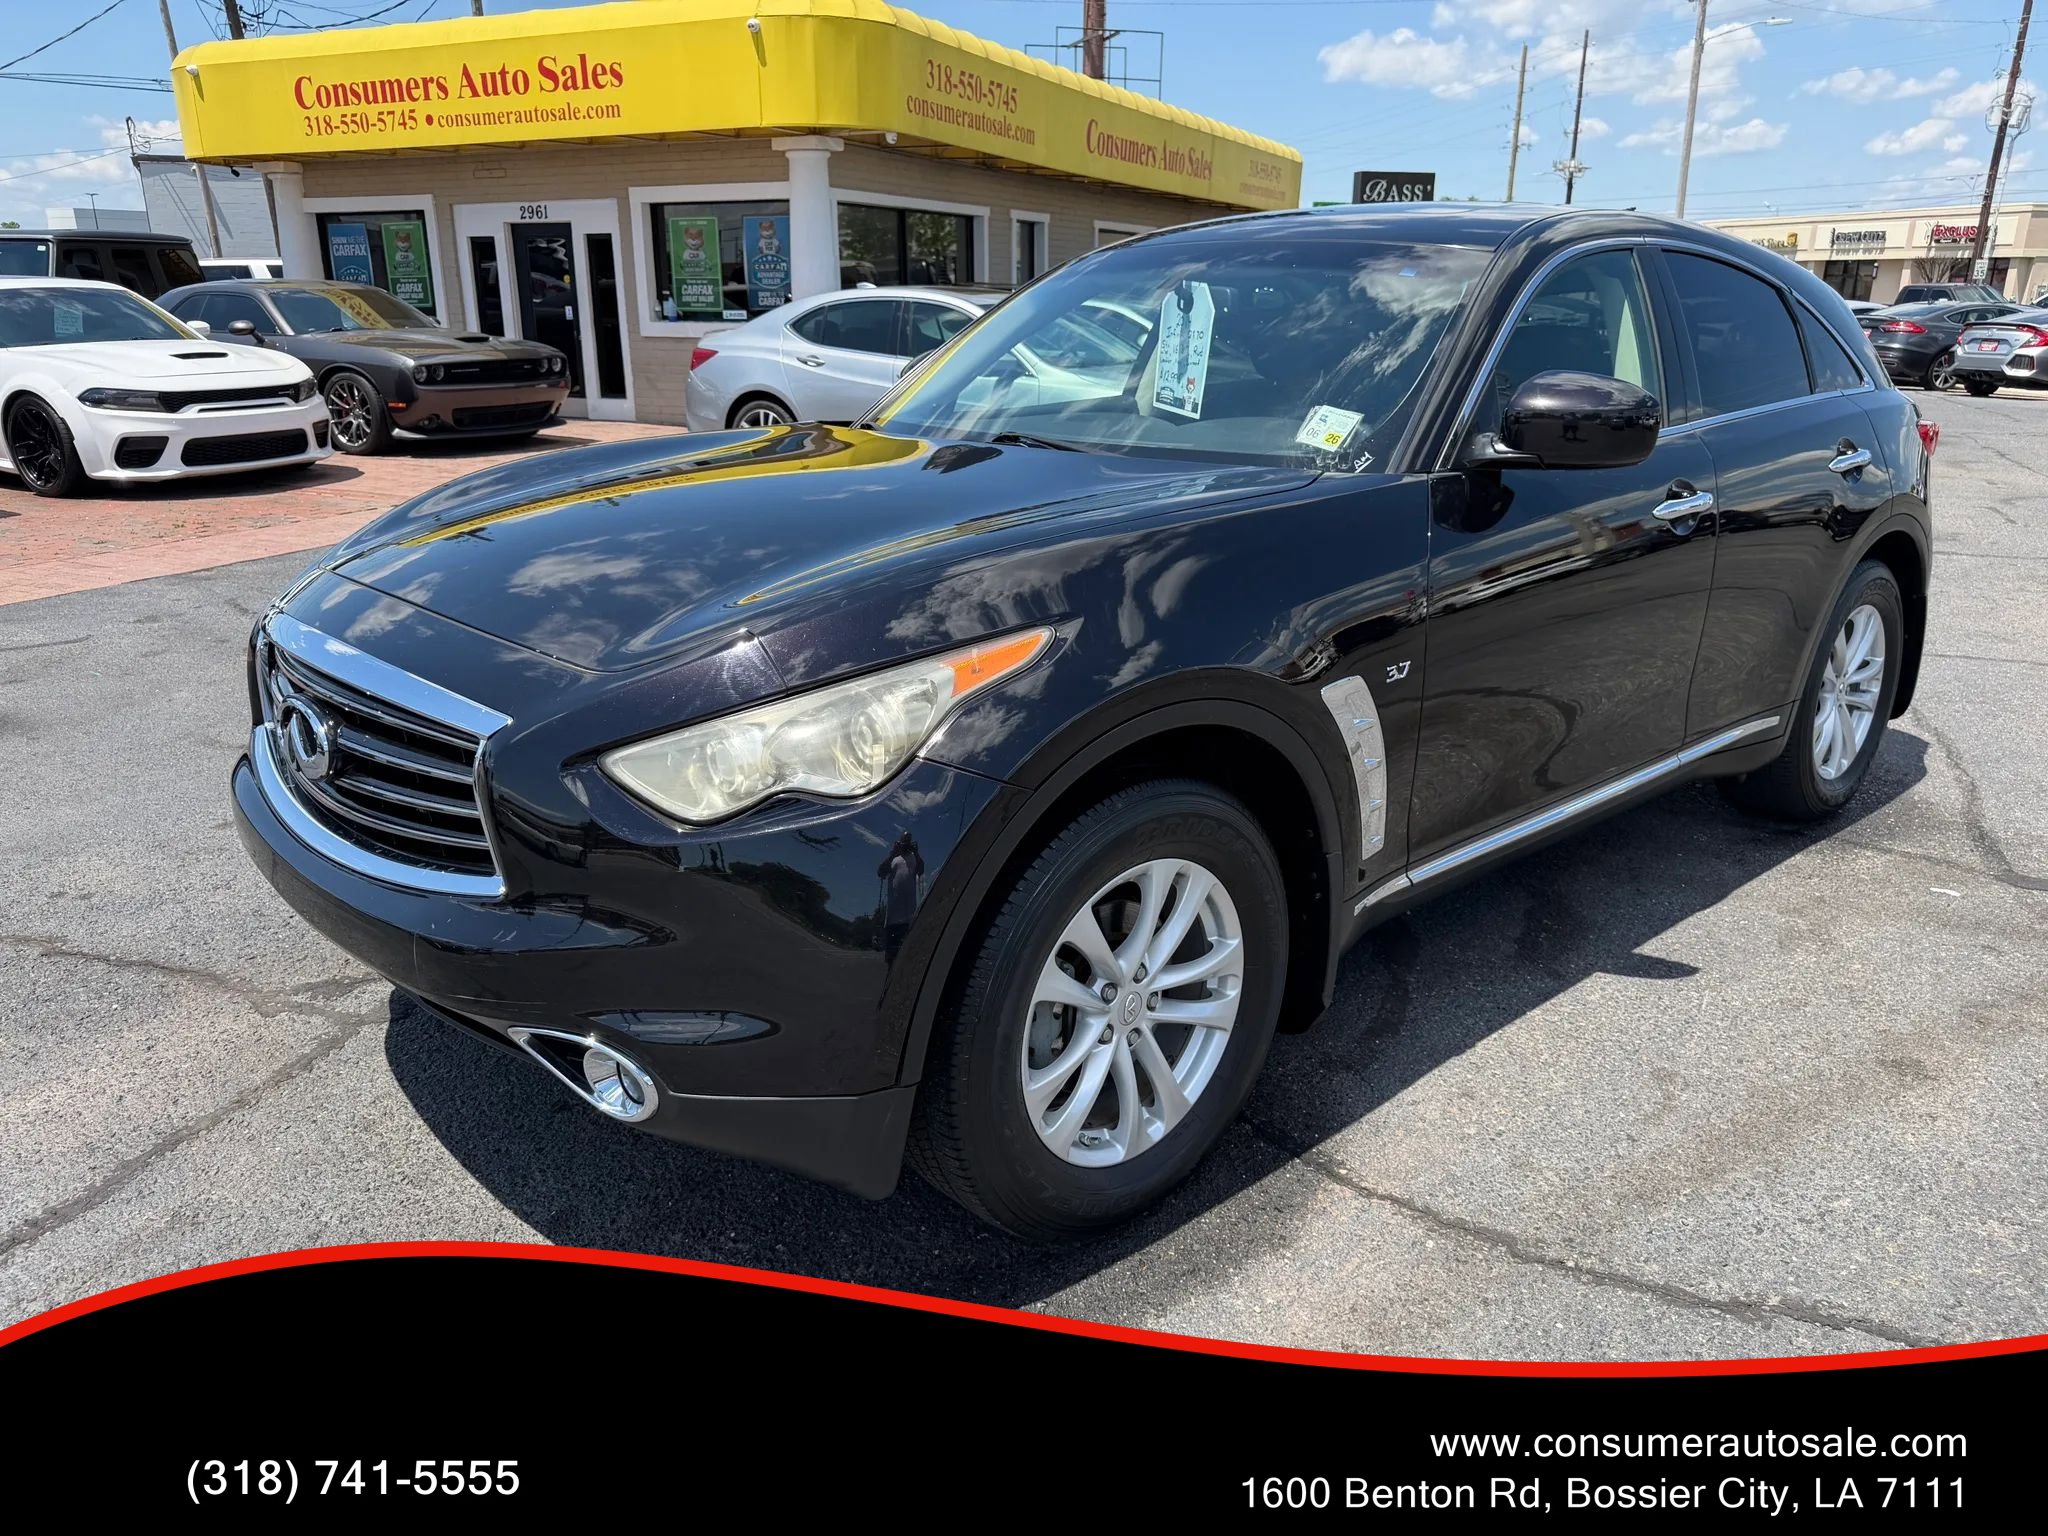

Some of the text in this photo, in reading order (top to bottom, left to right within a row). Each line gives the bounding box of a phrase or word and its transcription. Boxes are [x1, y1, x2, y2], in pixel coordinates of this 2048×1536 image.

[294, 53, 624, 110] Consumers Auto Sales
[926, 58, 1018, 114] 318-550-5745
[303, 102, 622, 137] 318-550-5745 consumerautosale.com
[906, 95, 1036, 145] consumerautosale.com
[1086, 118, 1213, 182] Consumers Auto Sales
[520, 205, 549, 219] 2961
[1933, 224, 1996, 238] EXCLUS
[333, 244, 367, 257] CARFAX
[1974, 269, 1985, 278] 35
[396, 283, 423, 293] CARFAX
[682, 284, 714, 295] CARFAX
[1305, 427, 1321, 439] 06
[1325, 433, 1341, 445] 26
